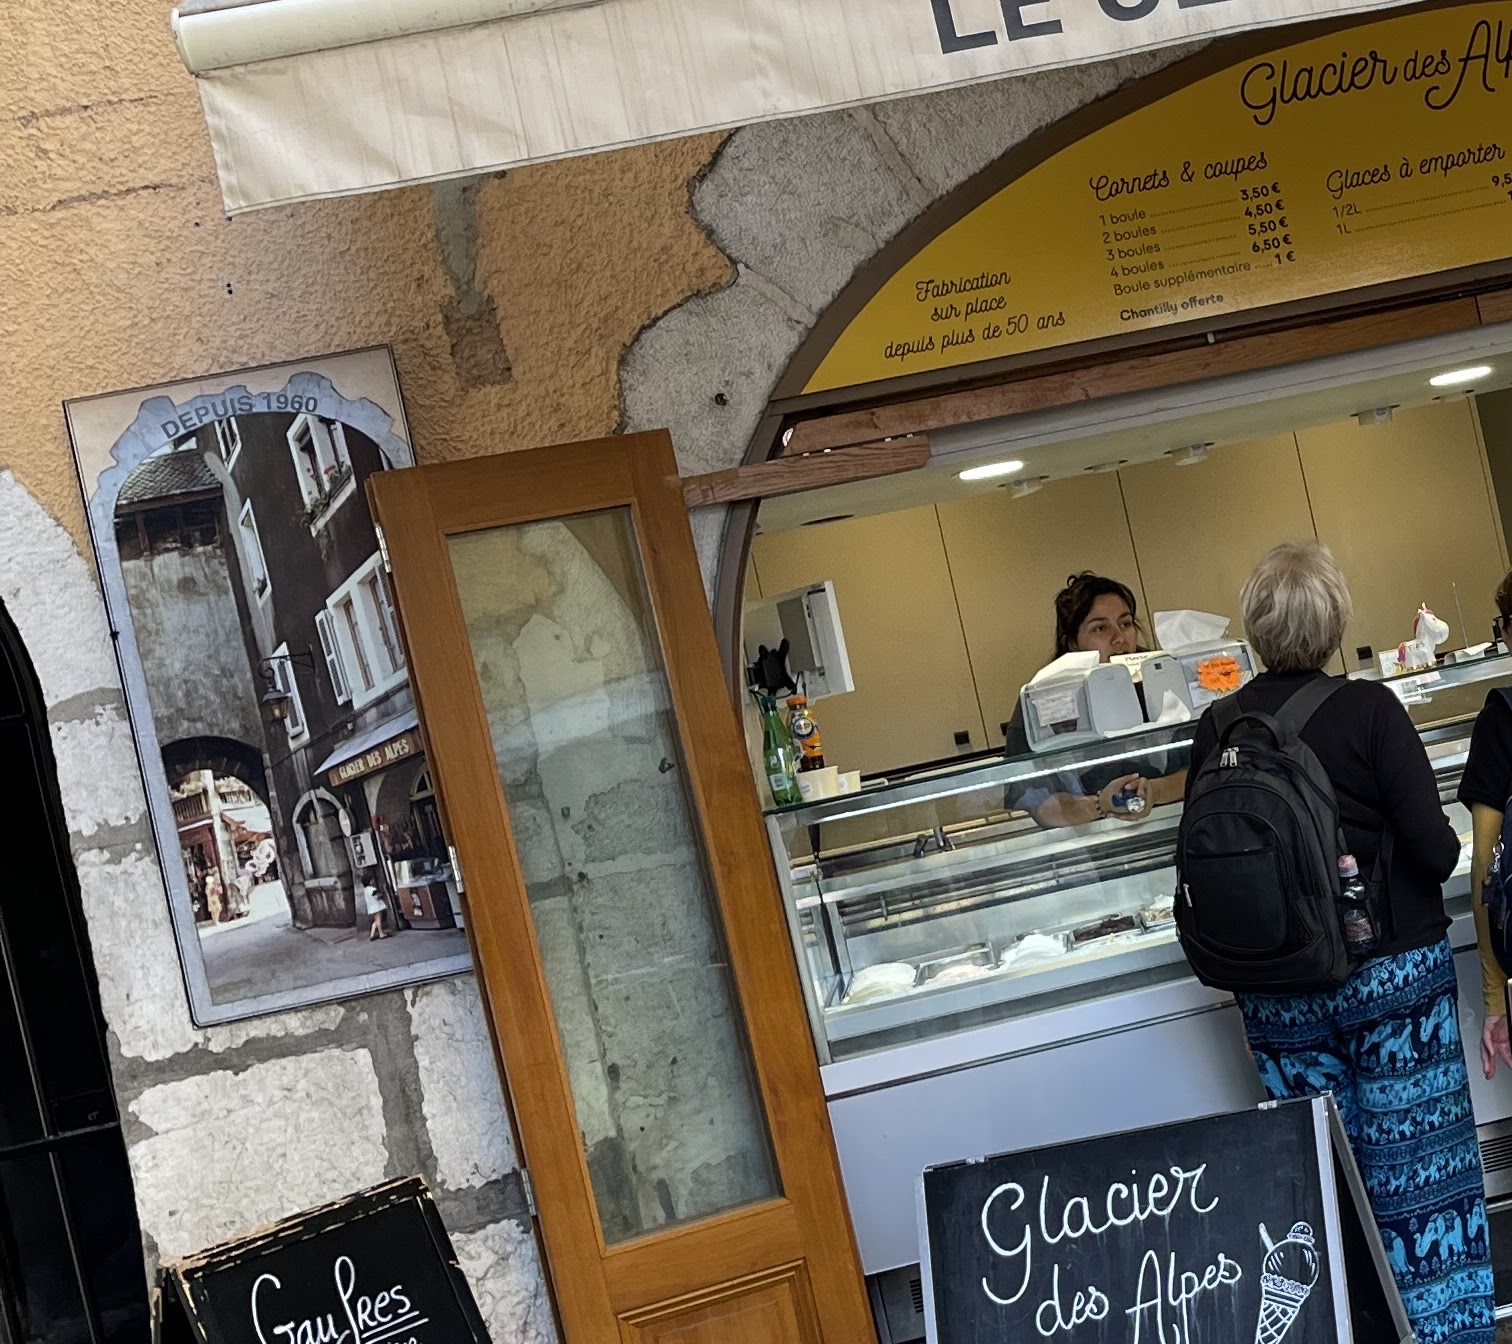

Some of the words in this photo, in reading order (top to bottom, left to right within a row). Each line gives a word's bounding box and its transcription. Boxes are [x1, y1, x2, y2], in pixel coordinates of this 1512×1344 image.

[1240, 50, 1399, 126] Glacier
[1402, 48, 1452, 83] des
[1089, 169, 1171, 202] Cornets
[1180, 161, 1195, 183] &
[1203, 151, 1269, 183] coupes
[1325, 163, 1392, 200] Glaces
[1398, 156, 1412, 179] à
[1418, 143, 1506, 178] emporter
[1099, 214, 1106, 227] 1
[1109, 208, 1147, 226] boule
[1332, 202, 1362, 219] 1/2L
[1102, 231, 1111, 244] 2
[1113, 224, 1158, 243] boules
[1336, 222, 1353, 235] 1L
[1106, 248, 1115, 261] 3
[1117, 241, 1161, 260] boules
[1109, 265, 1118, 278] 4
[1120, 258, 1165, 277] boules
[1113, 280, 1151, 297] Boule
[1153, 259, 1252, 290] supplémentaire
[915, 269, 1012, 303] Fabrication
[930, 303, 961, 322] sur
[963, 294, 1008, 318] place
[1119, 301, 1178, 322] Chantilly
[1180, 293, 1225, 310] offerte
[884, 334, 936, 360] depuis
[940, 327, 976, 354] plus
[981, 321, 1003, 340] de
[1005, 314, 1029, 337] 50
[1035, 310, 1066, 329] ans
[160, 392, 255, 443] DEPUIS
[262, 393, 319, 414] 1960
[384, 738, 410, 760] ALPES
[982, 1162, 1219, 1305] Glacier
[1035, 1264, 1110, 1337] des
